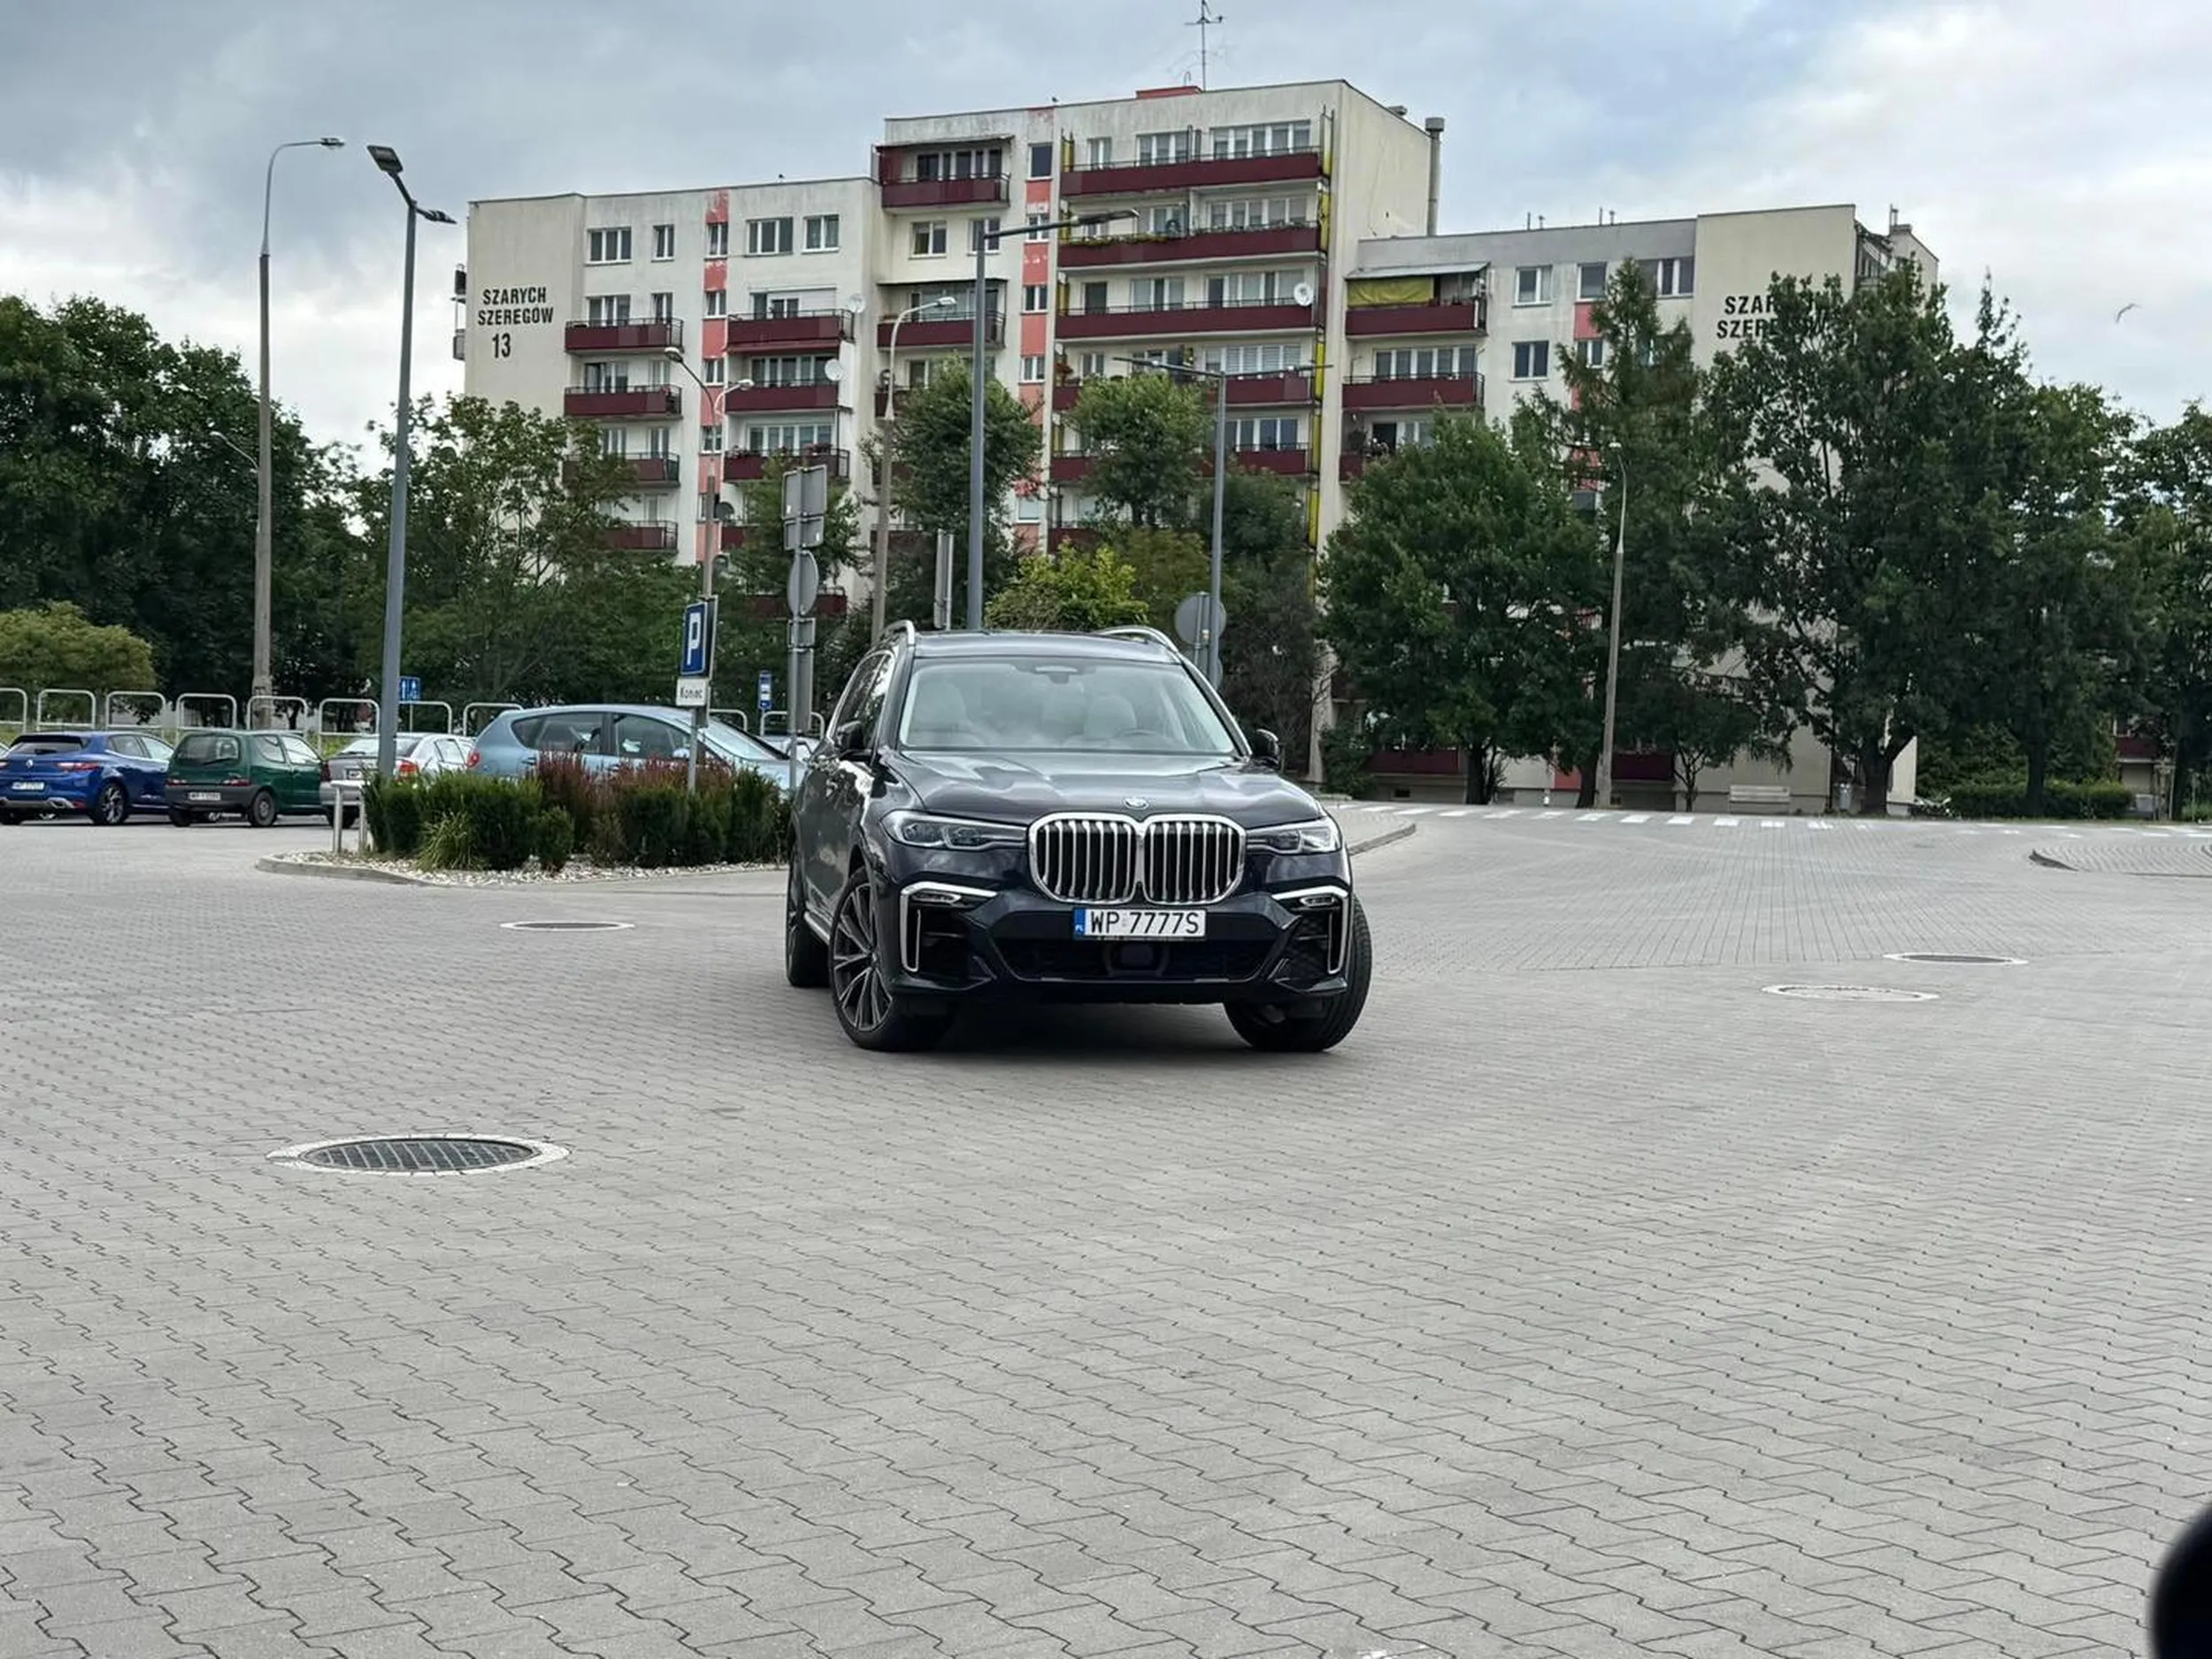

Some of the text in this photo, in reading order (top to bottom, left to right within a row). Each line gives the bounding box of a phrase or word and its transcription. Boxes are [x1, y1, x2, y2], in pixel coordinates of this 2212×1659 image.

[483, 287, 547, 305] SZARYCH
[1724, 296, 1775, 314] SZAR
[492, 333, 511, 358] 13
[687, 612, 702, 665] P
[1091, 911, 1200, 934] WP 7777S
